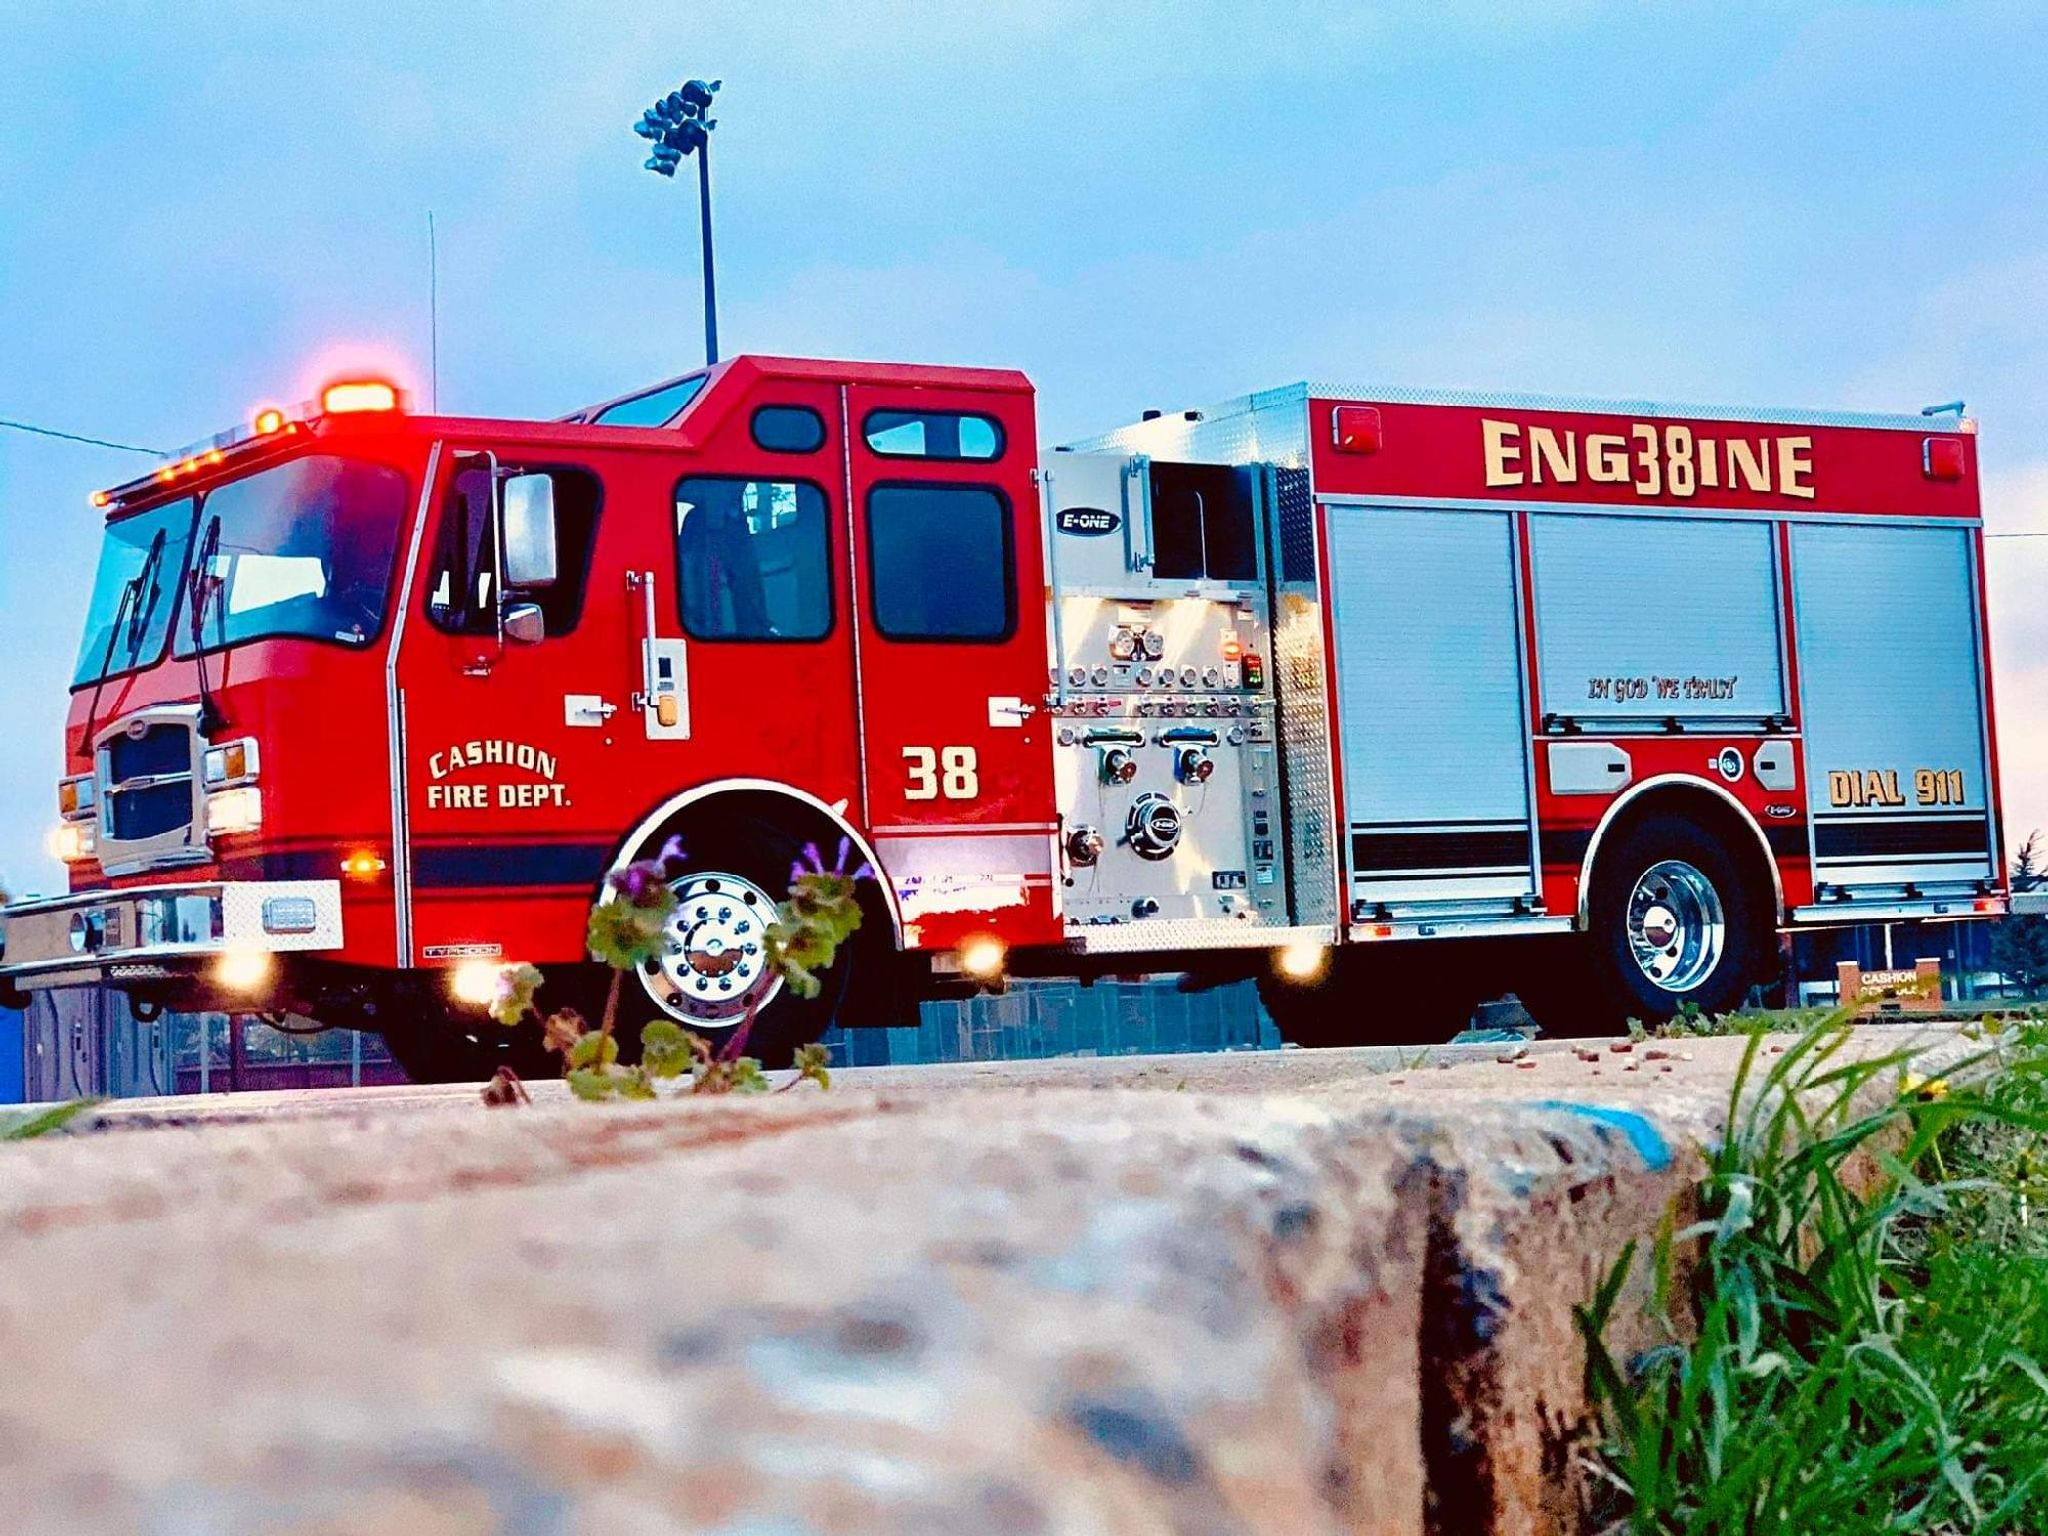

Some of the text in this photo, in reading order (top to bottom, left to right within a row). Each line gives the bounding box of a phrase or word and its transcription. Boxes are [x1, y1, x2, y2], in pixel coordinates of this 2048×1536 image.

[1062, 513, 1111, 529] E-ONE
[1588, 677, 1612, 699] IN
[1614, 678, 1649, 703] GOD
[1683, 675, 1738, 699] TRUST
[429, 740, 557, 780] CASHION
[902, 746, 979, 800] 38
[427, 784, 572, 809] FIRE DEPT.
[1829, 769, 1966, 807] DIAL 911
[1861, 971, 1917, 985] CASHION
